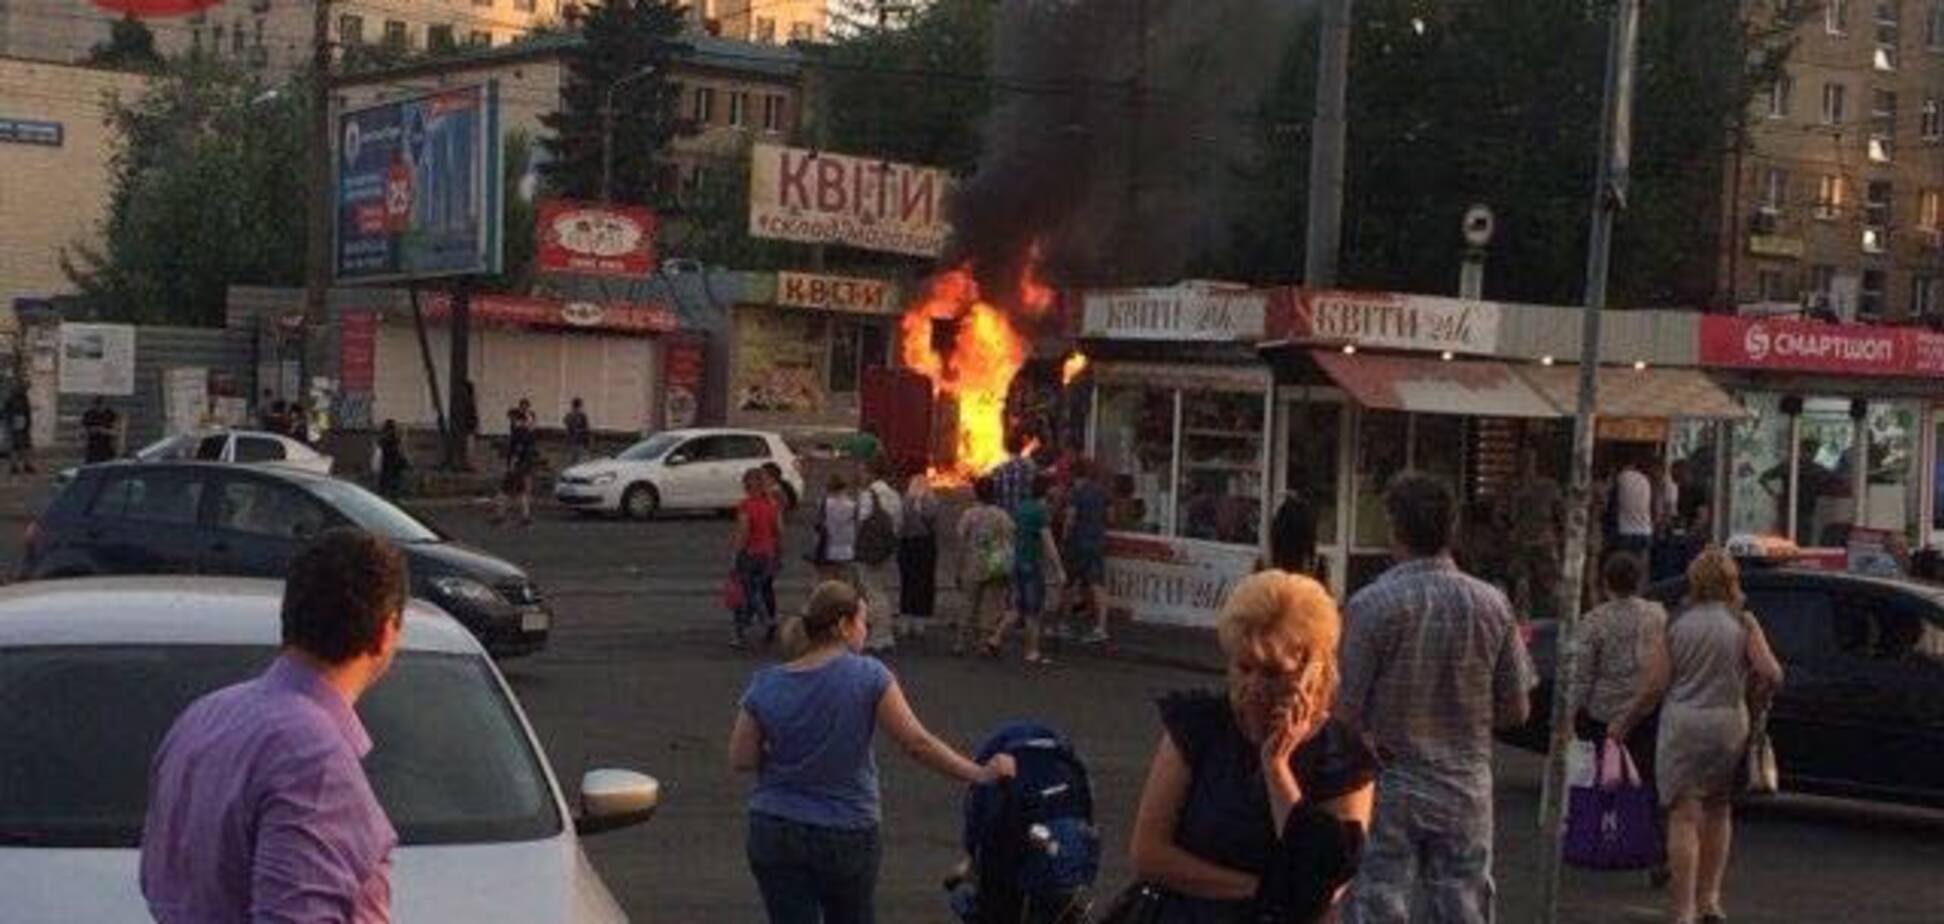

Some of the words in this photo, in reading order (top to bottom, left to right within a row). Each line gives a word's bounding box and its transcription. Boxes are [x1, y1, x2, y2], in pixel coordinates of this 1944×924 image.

[779, 152, 935, 225] КВІТИ
[1315, 301, 1418, 338] КВІТИ
[1773, 332, 1893, 362] СМАРТШОП
